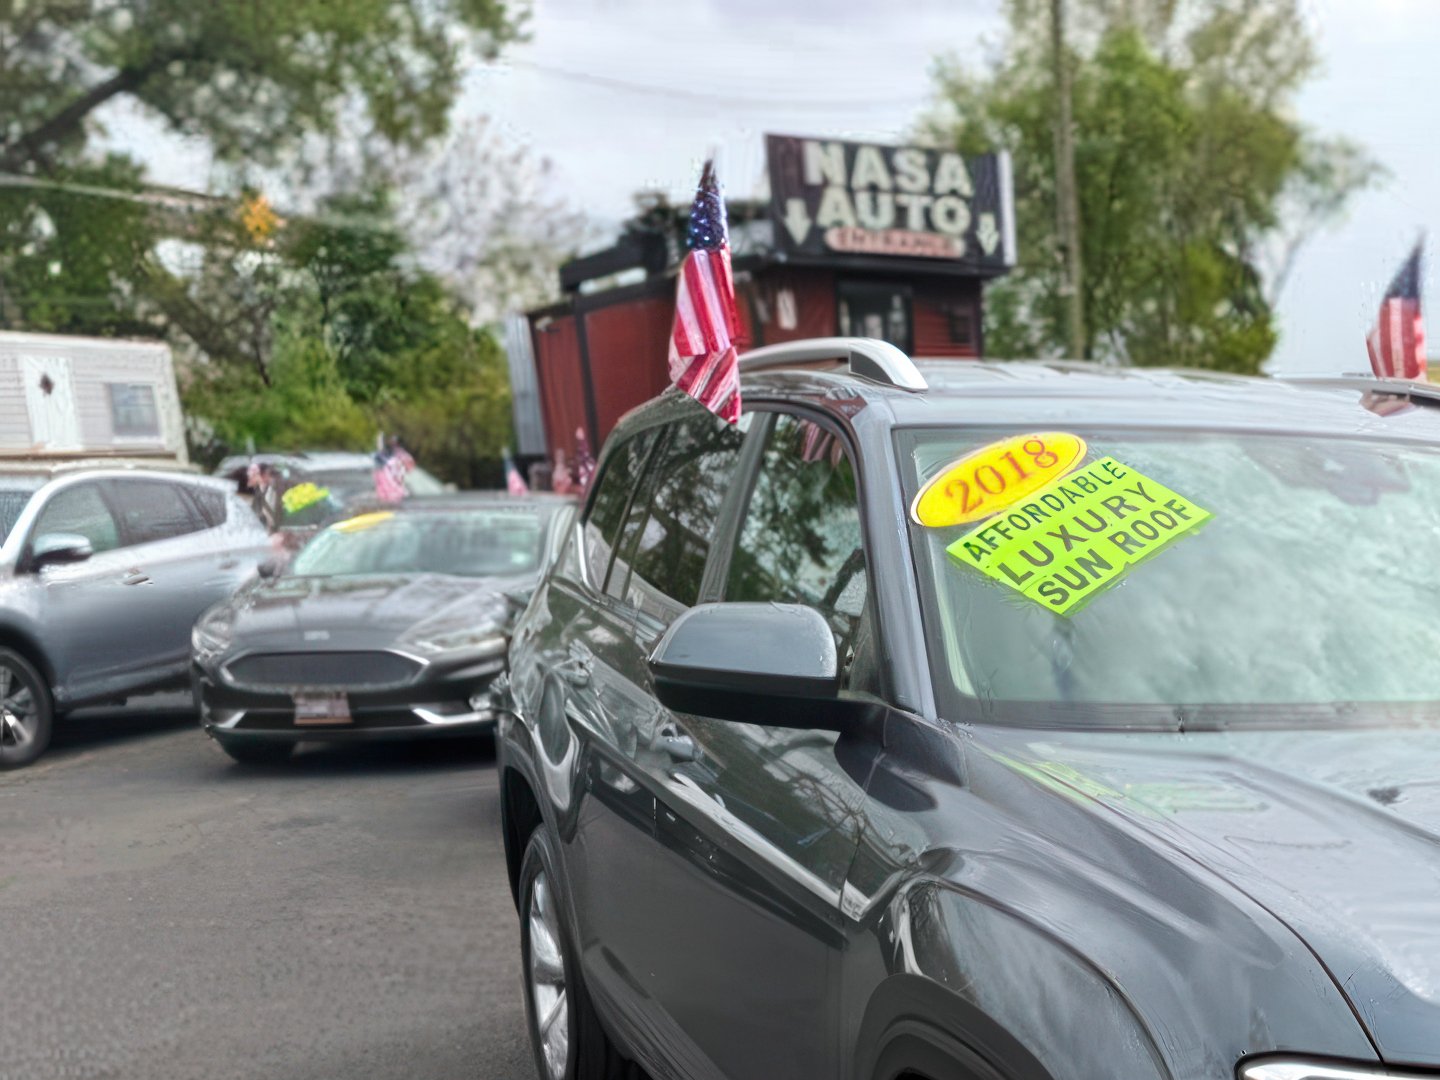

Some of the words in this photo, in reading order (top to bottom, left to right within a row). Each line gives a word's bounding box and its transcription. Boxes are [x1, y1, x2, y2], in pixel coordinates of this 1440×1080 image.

[803, 140, 973, 196] NASA
[816, 186, 971, 235] AUTO
[945, 436, 1059, 515] 2018
[962, 461, 1127, 562] AFFORDABLE
[997, 481, 1156, 586] LUXURY
[1037, 548, 1114, 606] SUN
[1108, 499, 1193, 555] ROOF
